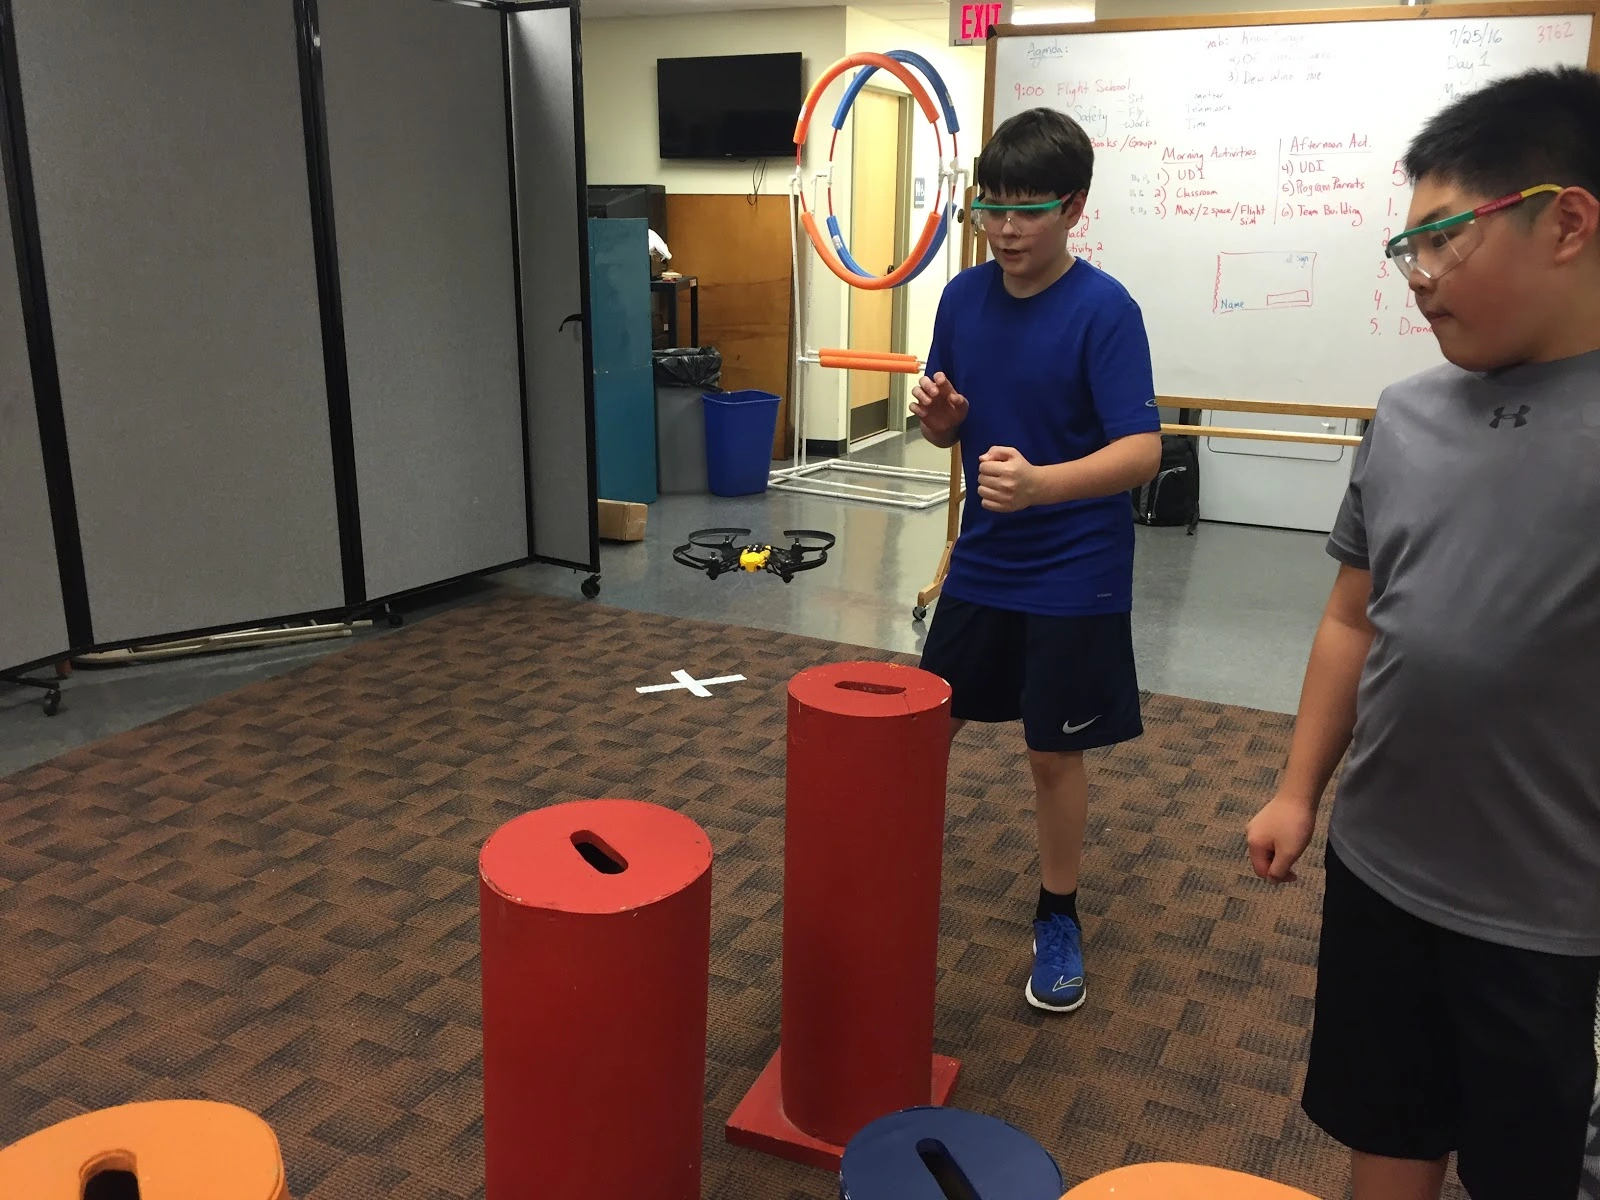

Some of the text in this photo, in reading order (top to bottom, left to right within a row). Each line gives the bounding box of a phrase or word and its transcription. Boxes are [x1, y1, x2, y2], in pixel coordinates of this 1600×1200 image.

[961, 4, 1001, 39] EXIT
[1450, 23, 1502, 48] 7/25/16
[1027, 39, 1069, 67] Agenda:
[1447, 50, 1490, 85] Day 1
[1014, 78, 1131, 107] 9:00 Flight School
[1074, 104, 1108, 138] Safety
[1290, 132, 1371, 152] Afternoon Act.
[1162, 145, 1257, 171] Morning Activities
[1282, 160, 1325, 176] 4) UDI
[1178, 169, 1205, 181] UDI
[1282, 176, 1365, 197] 5) Program Parrots
[1154, 186, 1167, 203] 2)
[1176, 187, 1218, 199] Classroom
[1154, 203, 1167, 219] 3)
[1281, 202, 1363, 227] 6) Team Building
[1220, 299, 1245, 309] Name
